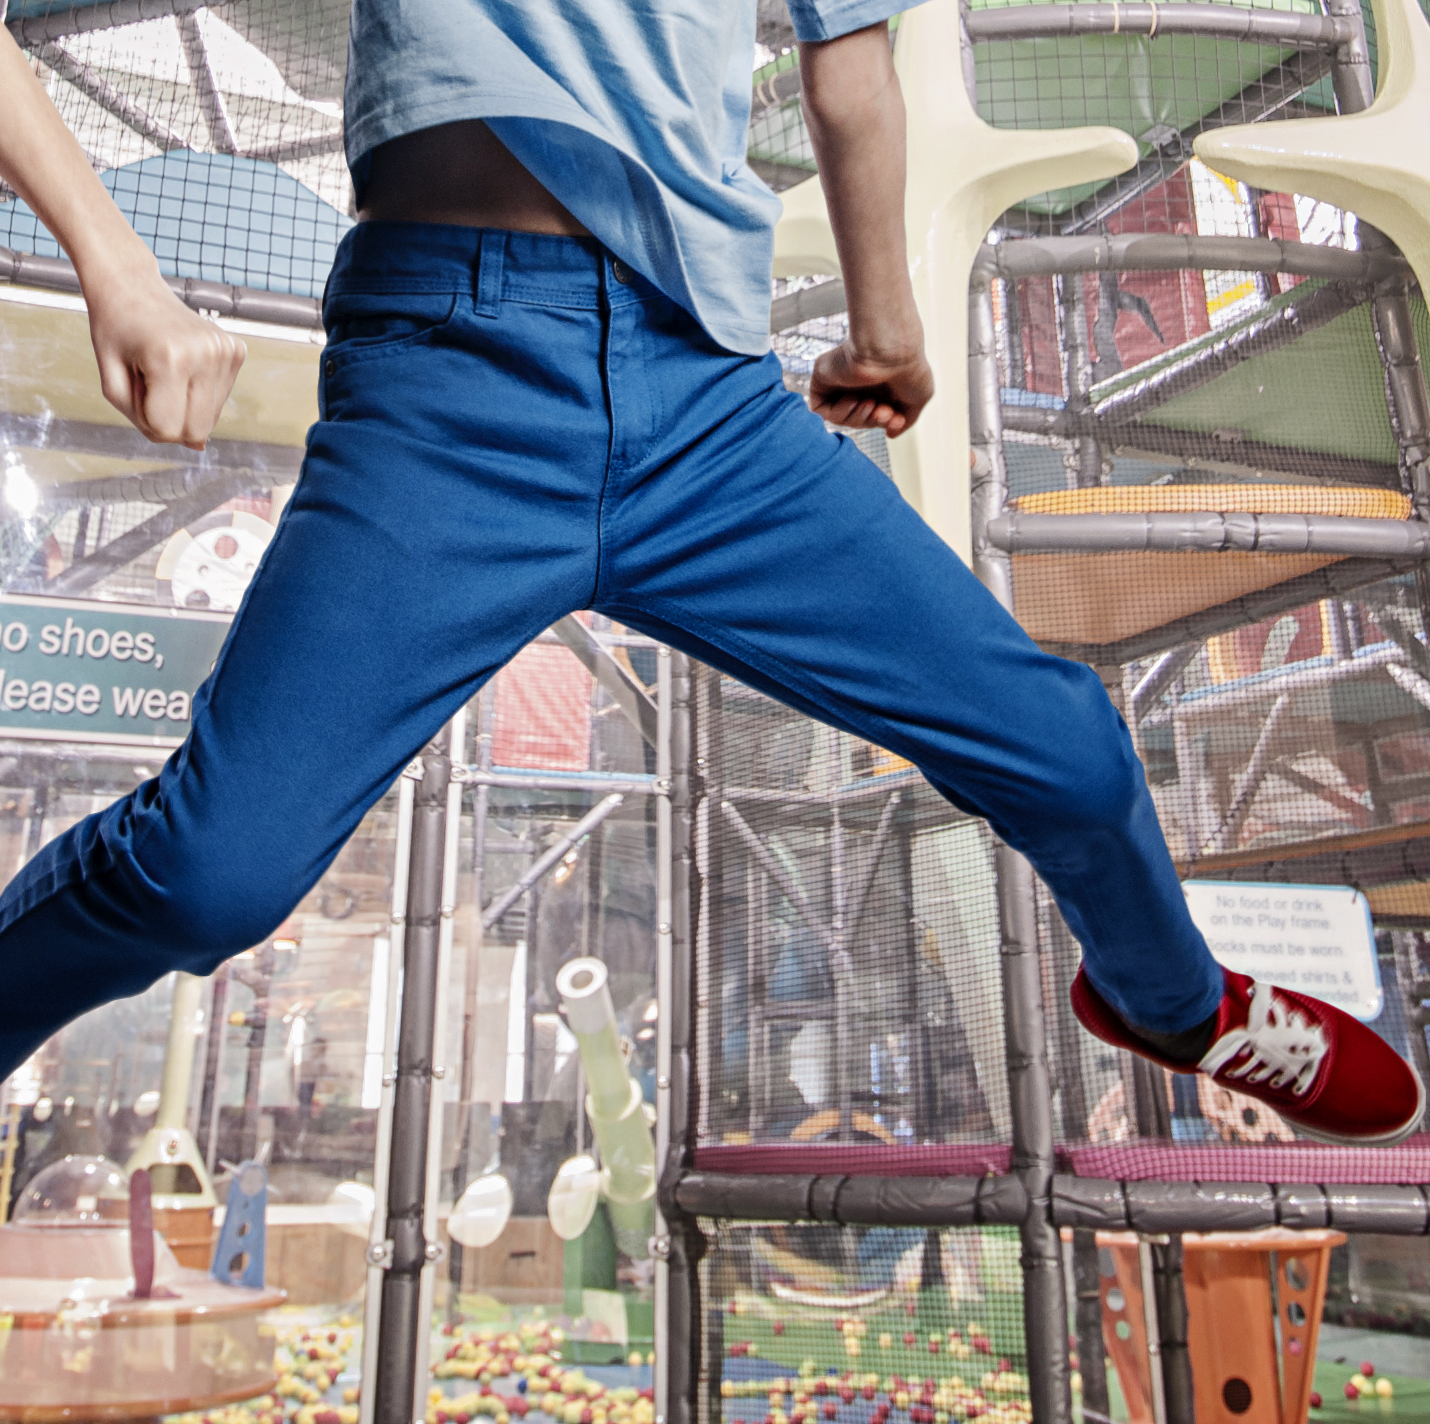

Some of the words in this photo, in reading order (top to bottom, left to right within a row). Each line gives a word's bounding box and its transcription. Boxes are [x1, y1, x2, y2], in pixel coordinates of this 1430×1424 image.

[38, 617, 164, 669] shoes,
[112, 686, 192, 722] wea
[1216, 895, 1235, 908] No
[1239, 895, 1269, 910] food
[1273, 899, 1287, 910] or
[1292, 898, 1323, 912] drink
[1210, 915, 1227, 926] on
[1231, 914, 1253, 926] the
[1257, 913, 1286, 932] Play
[1251, 942, 1284, 955] must
[1287, 943, 1305, 956] be
